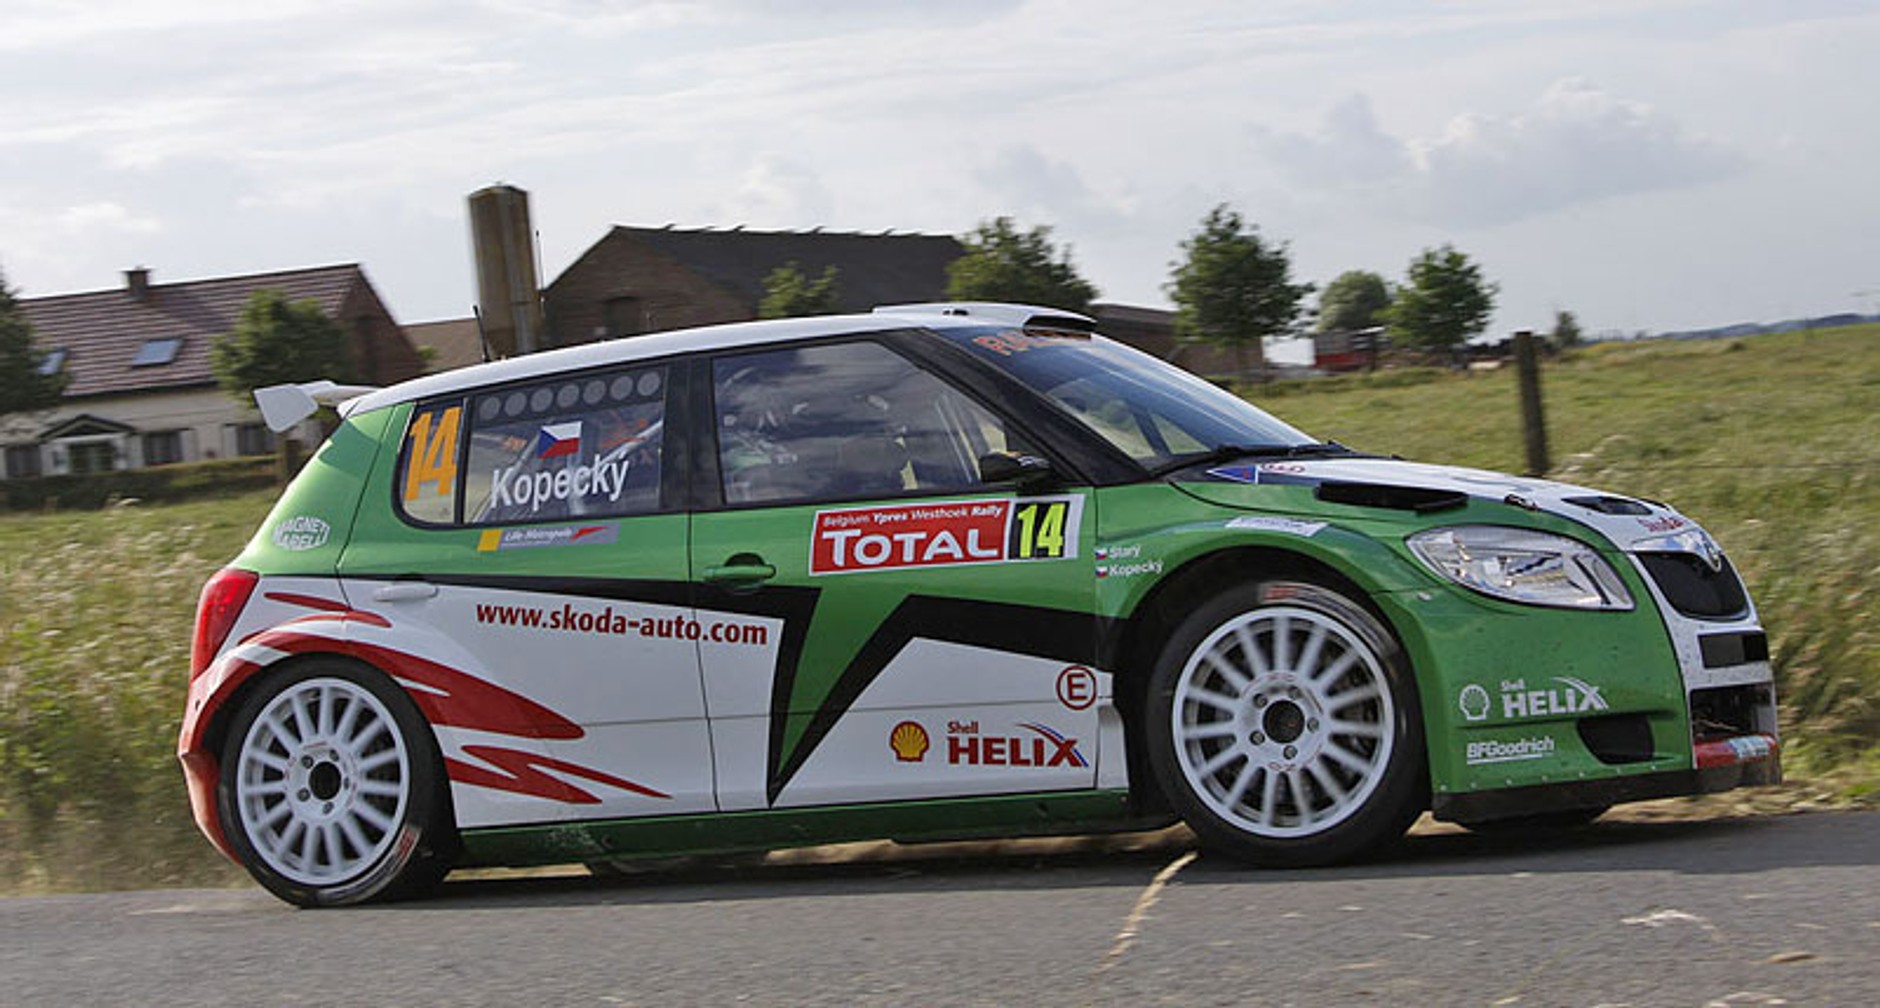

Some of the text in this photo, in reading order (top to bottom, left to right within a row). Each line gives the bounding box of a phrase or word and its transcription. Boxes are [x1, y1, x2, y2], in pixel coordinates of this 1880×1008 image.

[404, 406, 461, 500] 14
[490, 452, 628, 511] Kopecký
[823, 505, 1003, 527] Belgium Ypres Westhoek Rally
[1016, 503, 1065, 558] 14
[476, 603, 768, 646] www.skoda-auto.com
[1502, 686, 1602, 717] HELIX
[947, 721, 979, 734] Shell
[947, 736, 1083, 768] HELIX
[1466, 735, 1554, 758] BFGoodrich
